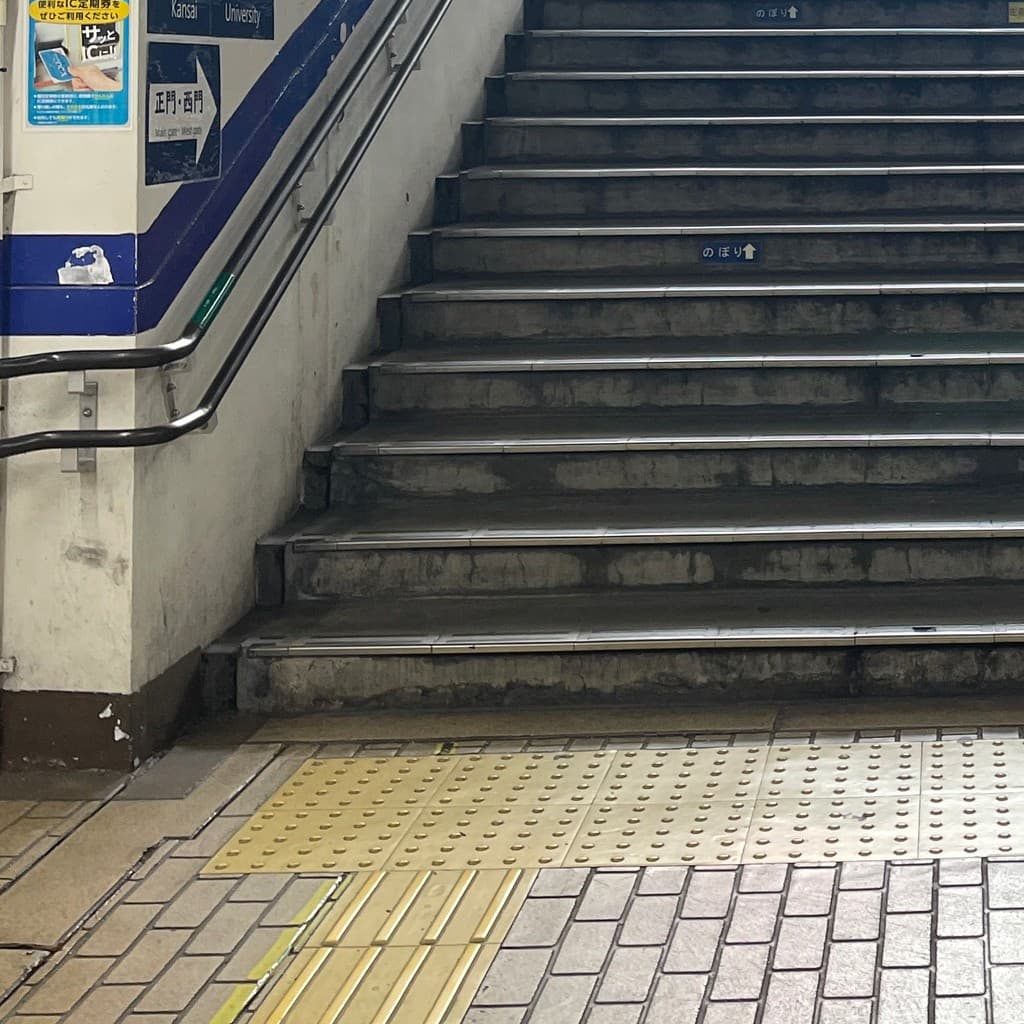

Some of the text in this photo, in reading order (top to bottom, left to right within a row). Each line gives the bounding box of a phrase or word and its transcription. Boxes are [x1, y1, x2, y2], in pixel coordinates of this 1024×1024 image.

[40, 12, 119, 21] ぜひご利用ください
[224, 2, 261, 29] University
[702, 246, 742, 258] のぼり
